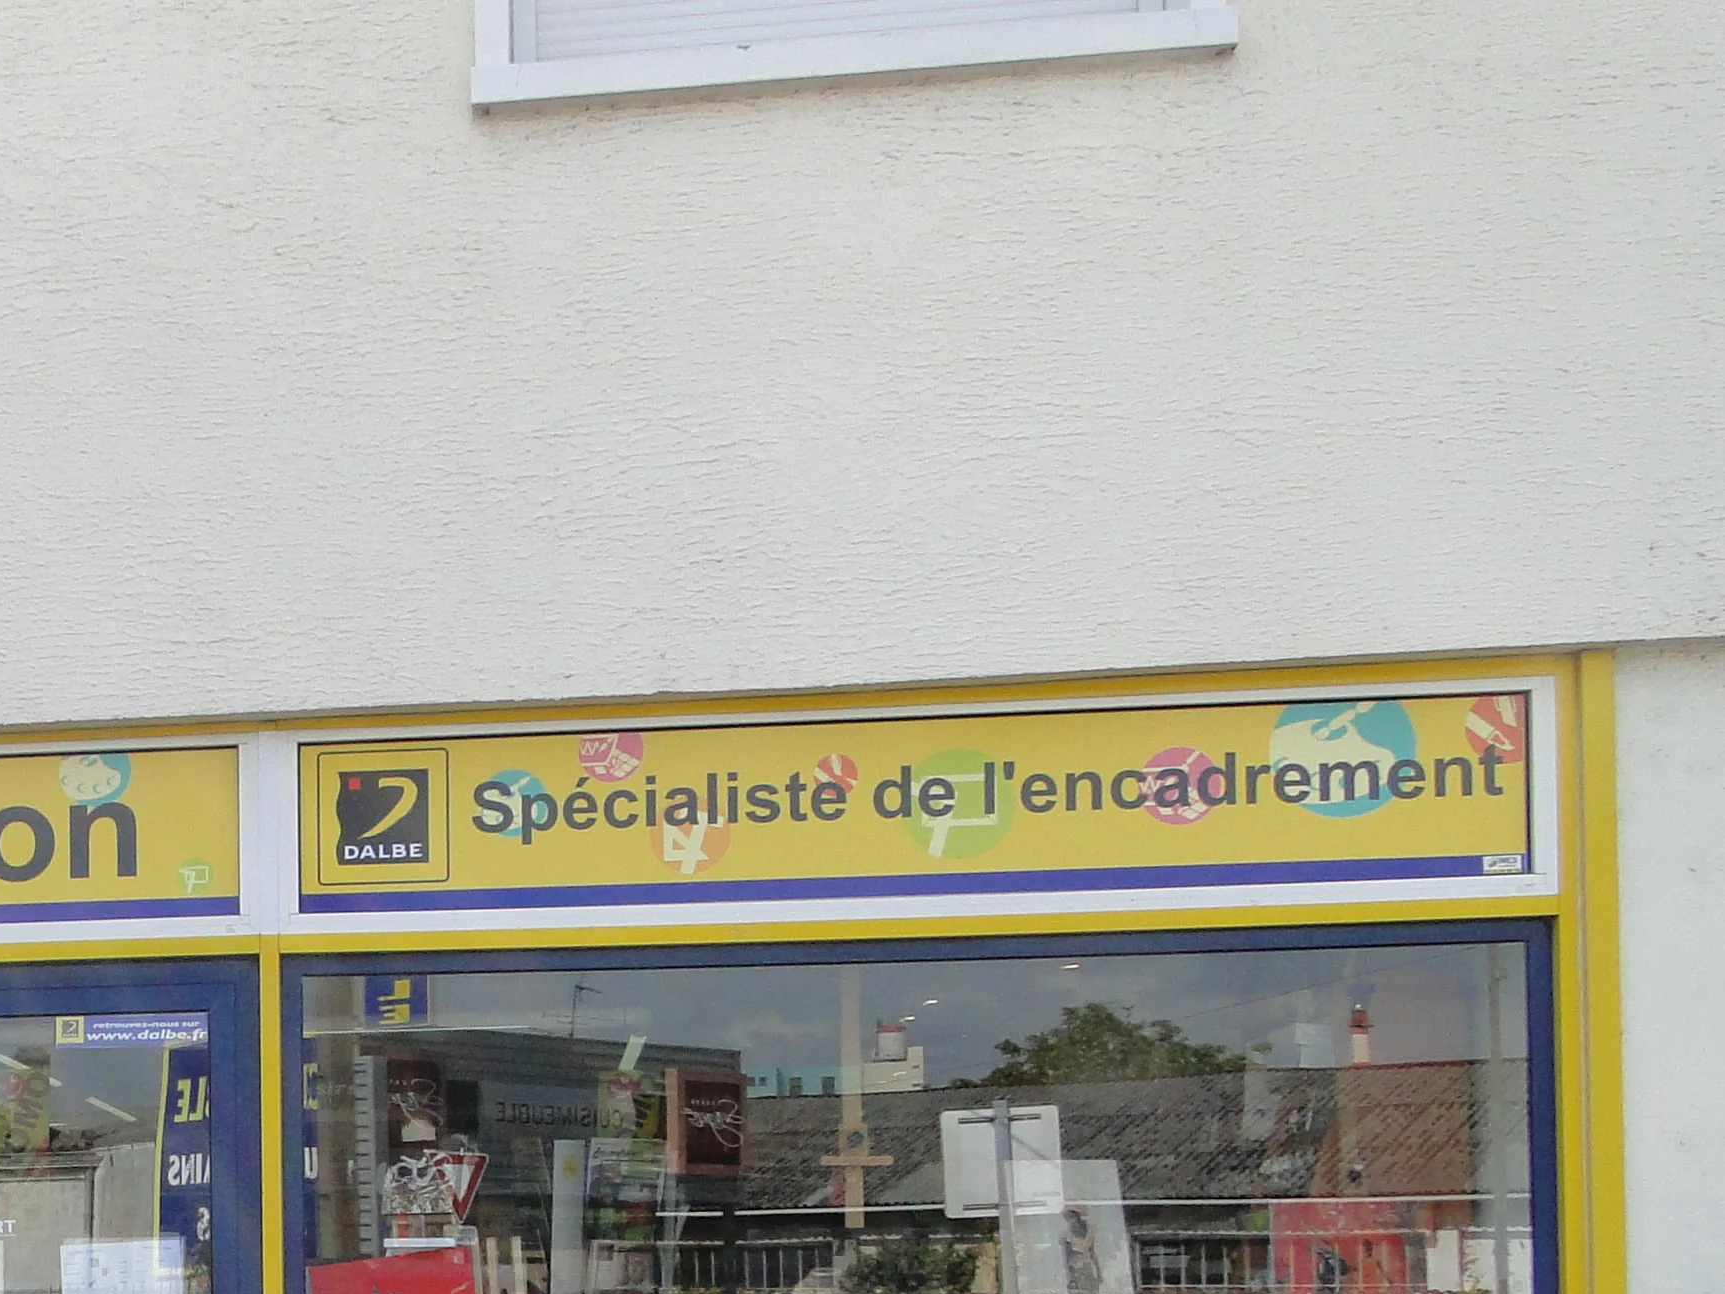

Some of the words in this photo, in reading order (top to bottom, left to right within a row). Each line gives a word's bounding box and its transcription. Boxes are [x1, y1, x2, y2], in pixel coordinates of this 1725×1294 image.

[473, 768, 848, 843] Spécialiste
[873, 767, 957, 821] de
[983, 744, 1505, 814] l'encadrement
[344, 843, 423, 859] DALBE
[86, 1028, 208, 1041] www.dalbe.fr
